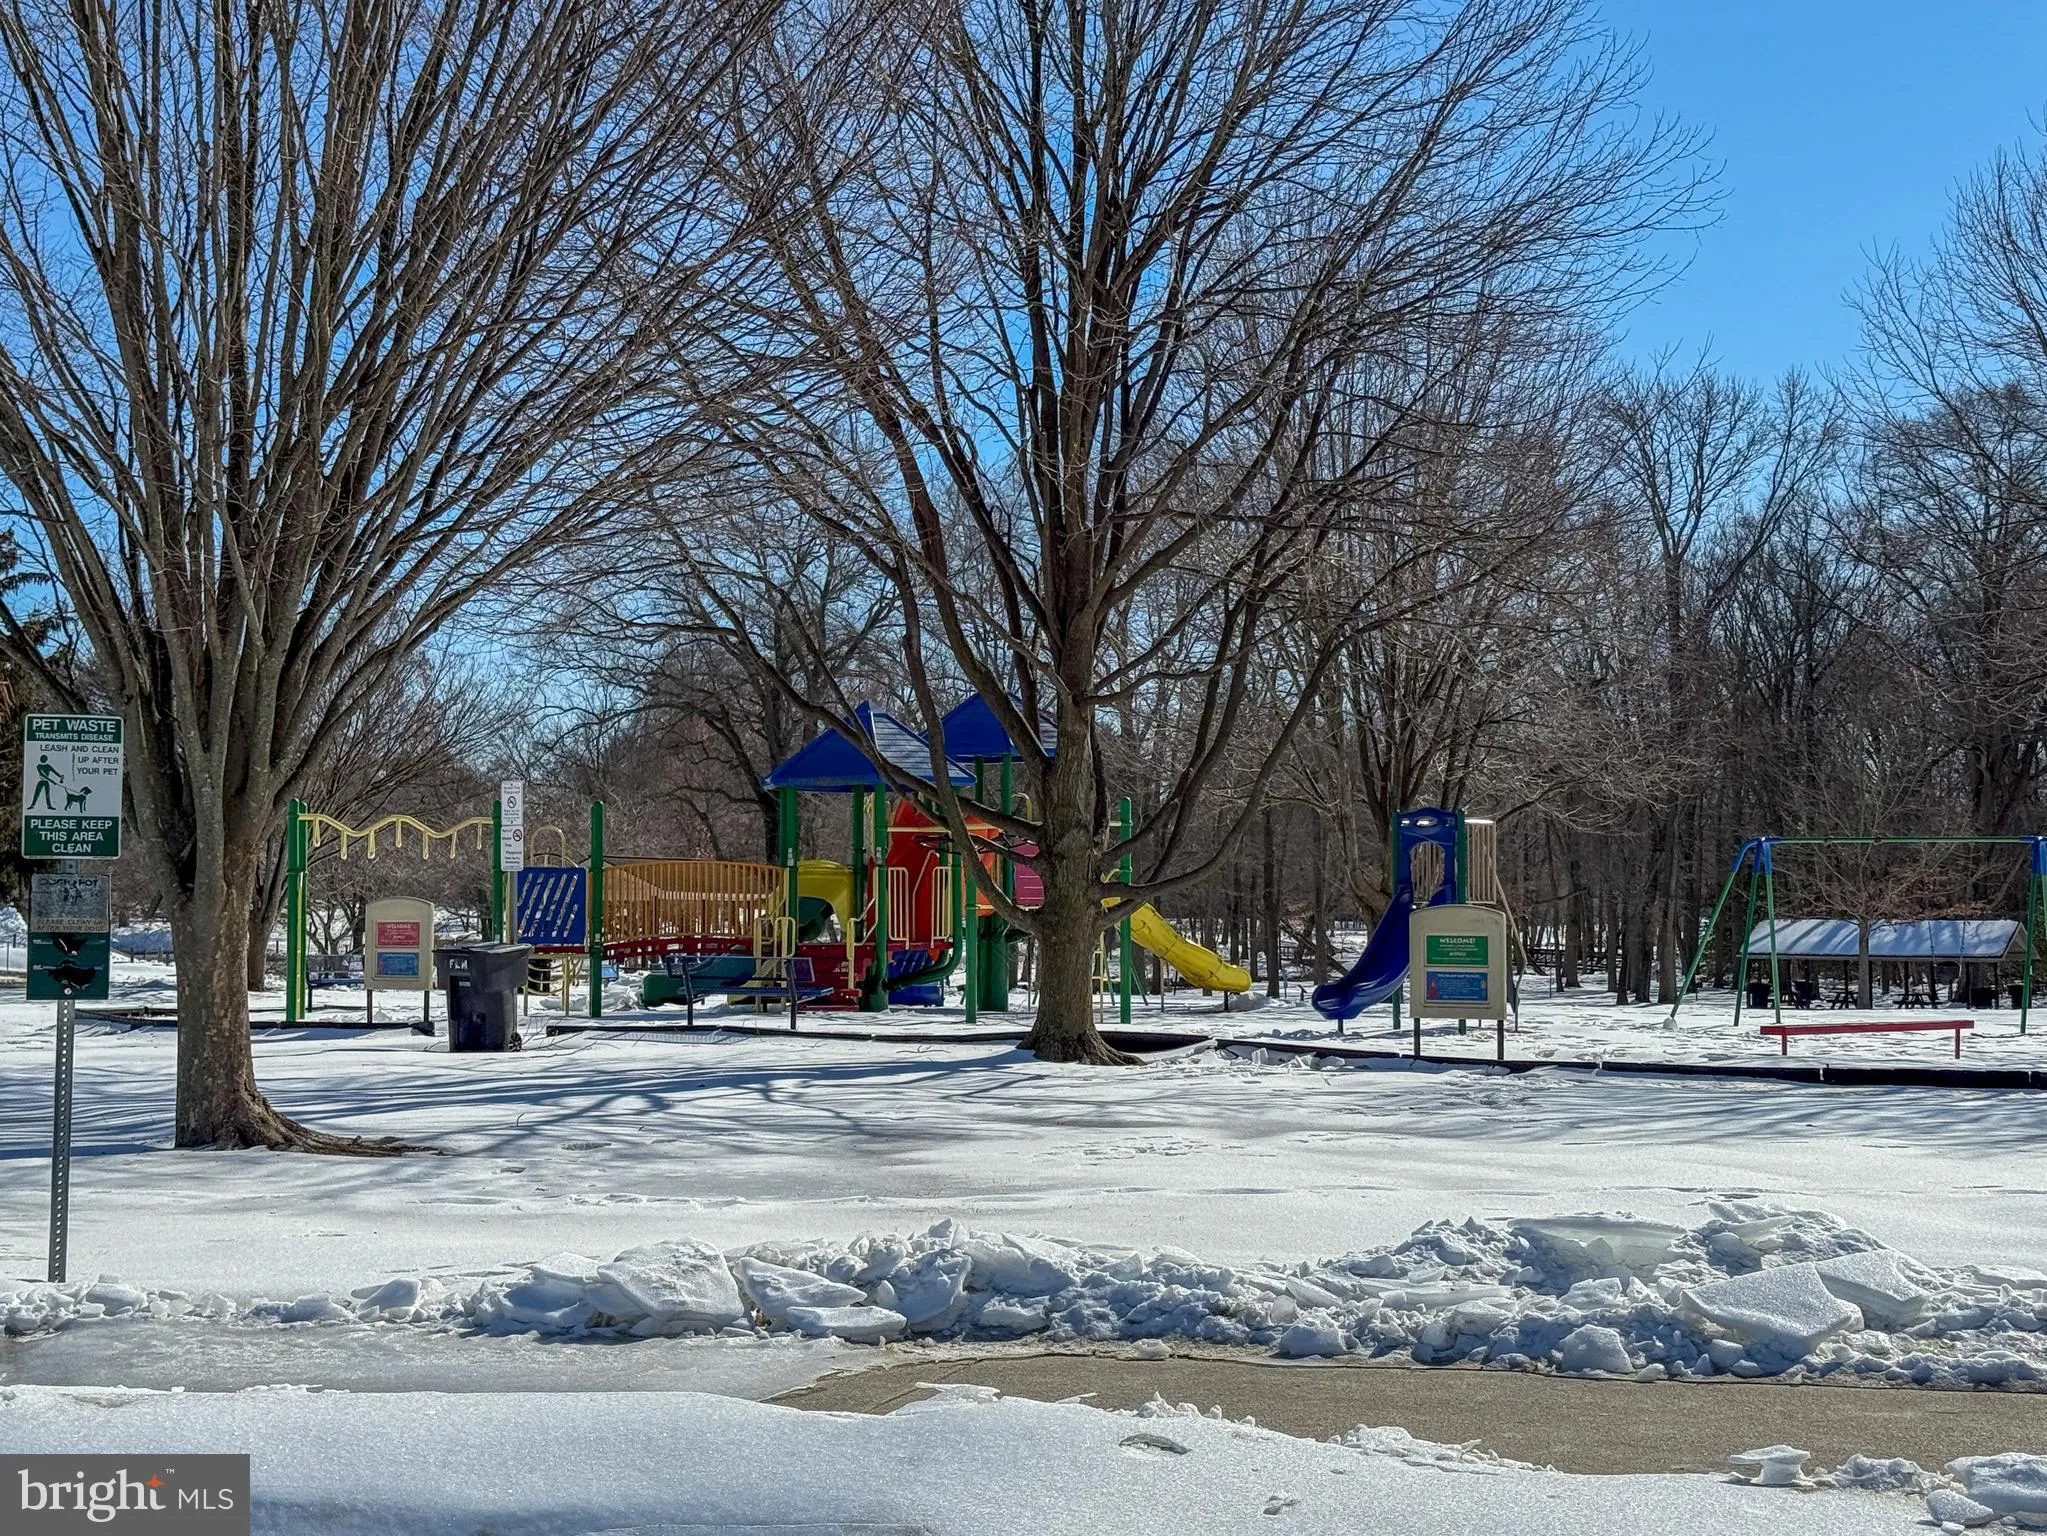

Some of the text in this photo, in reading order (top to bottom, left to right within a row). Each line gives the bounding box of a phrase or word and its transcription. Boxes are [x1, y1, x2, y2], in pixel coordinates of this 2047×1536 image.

[32, 719, 116, 732] PET WASTE
[35, 732, 113, 741] TRANSMITS DISEASE
[40, 744, 119, 753] LEASH AND CLEAN
[77, 756, 119, 764] UP AFTER
[77, 767, 99, 775] YOUR
[30, 819, 112, 830] PLEASE KEEP
[39, 831, 104, 841] THIS AREA
[52, 843, 92, 853] CLEAN
